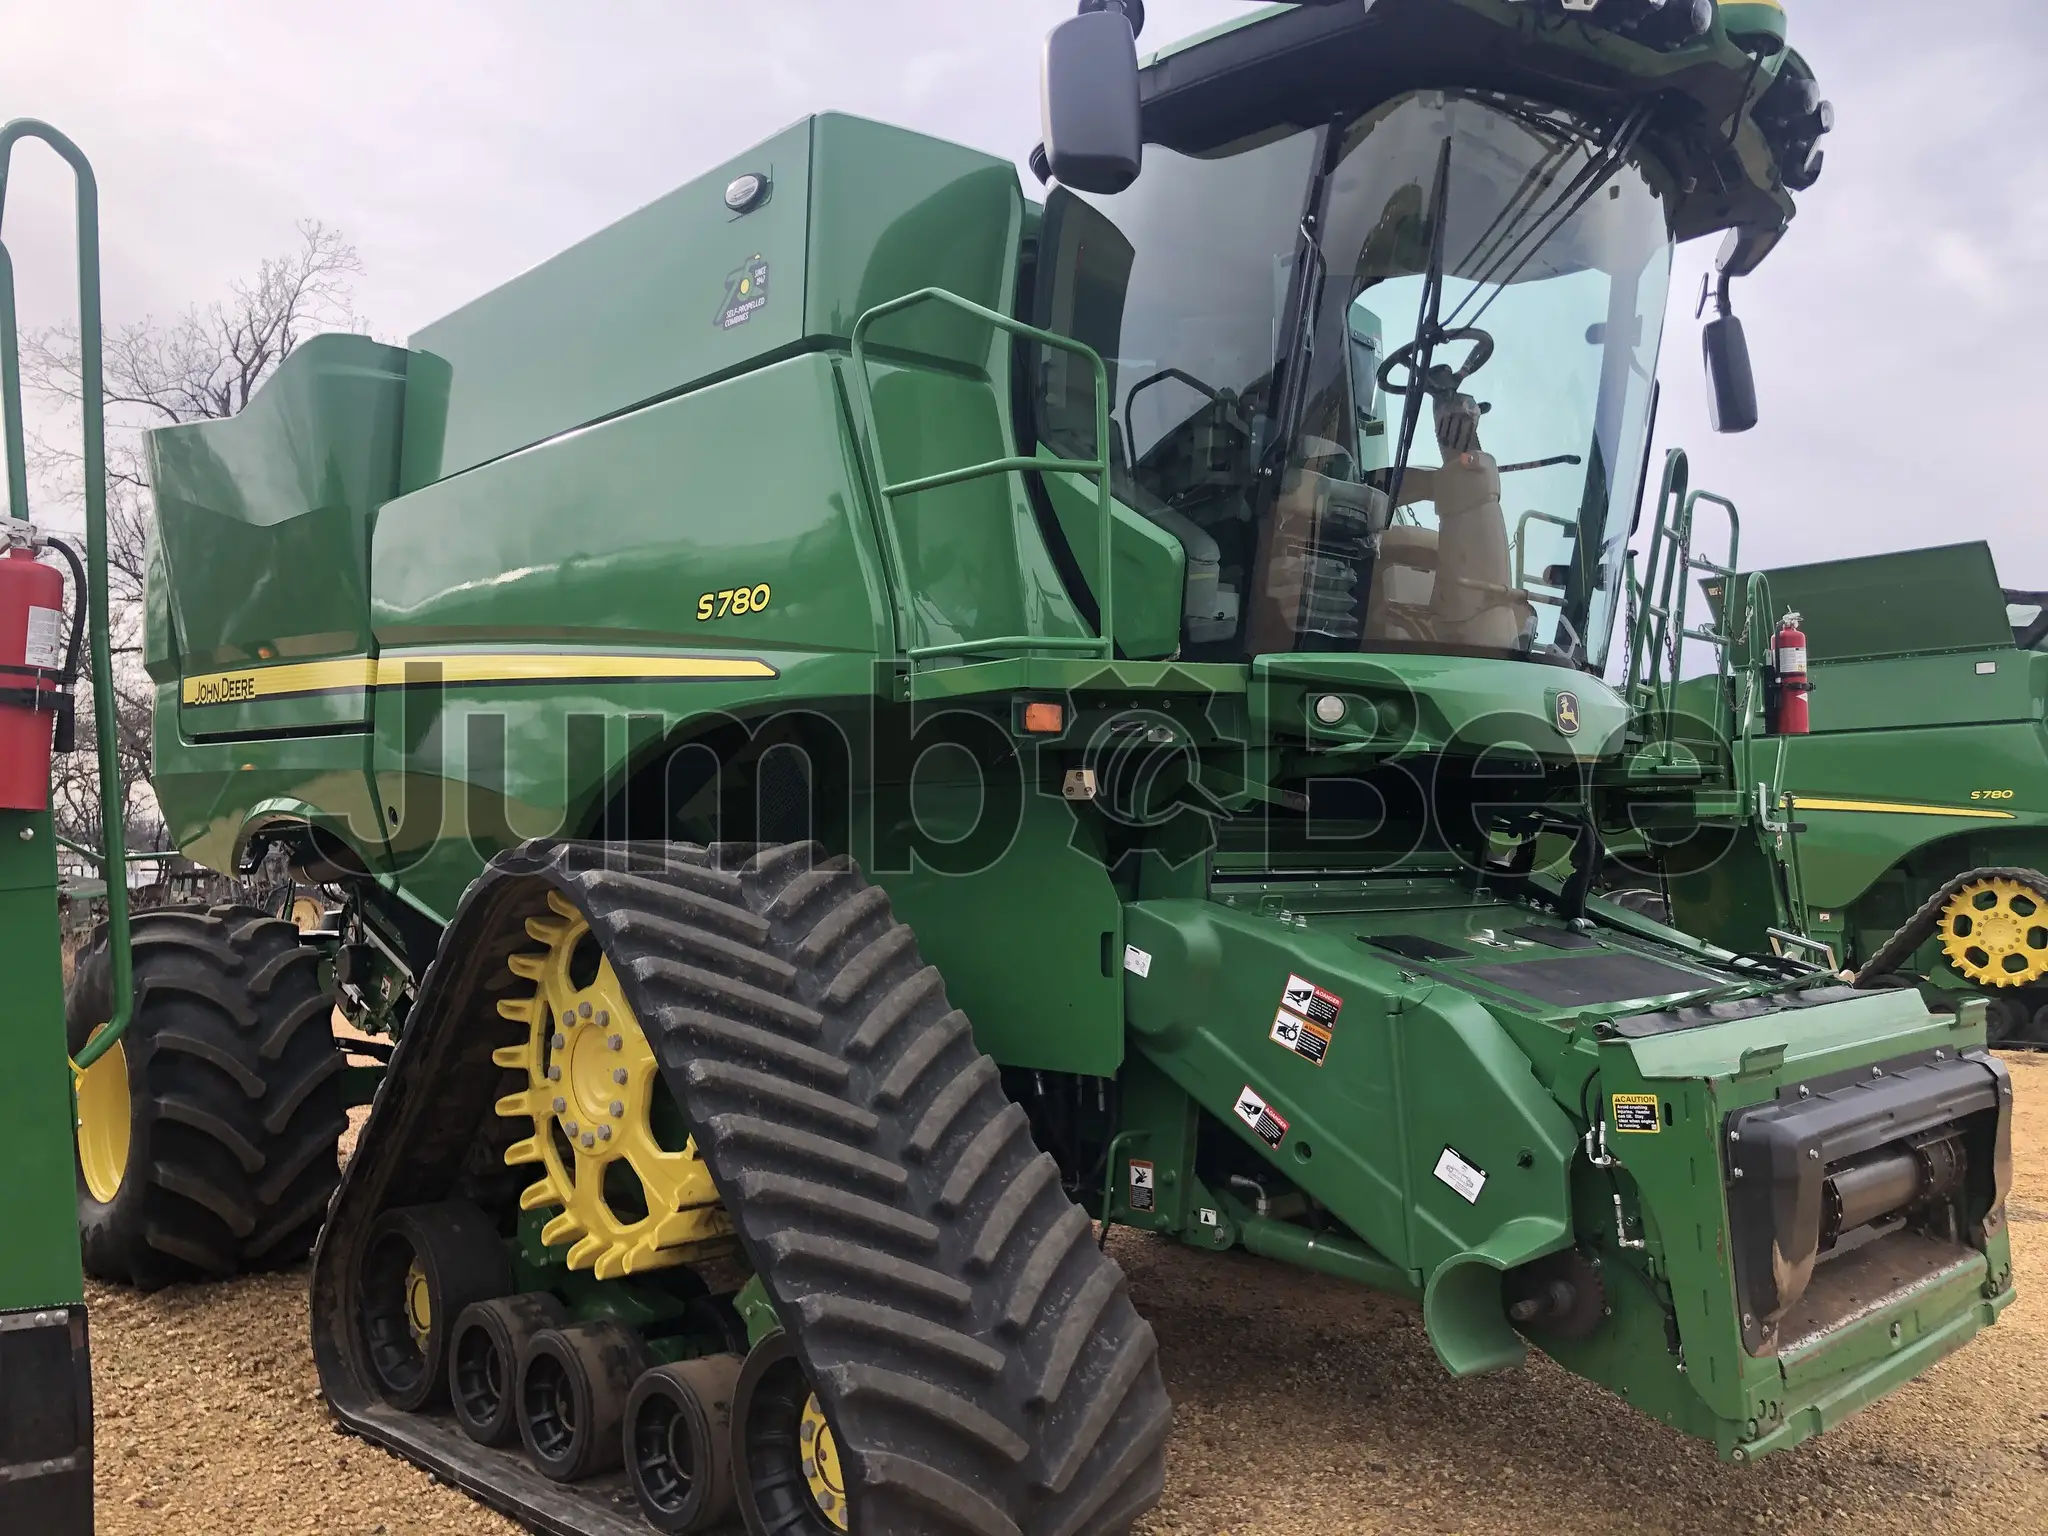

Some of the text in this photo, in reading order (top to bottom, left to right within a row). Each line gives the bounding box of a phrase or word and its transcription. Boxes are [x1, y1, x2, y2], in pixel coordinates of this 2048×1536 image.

[725, 297, 765, 319] SELF-PROPELLED
[724, 312, 749, 327] COMBINES
[697, 582, 771, 621] S780
[195, 678, 255, 703] JOHN DEERE
[1970, 789, 2014, 800] S780
[1319, 991, 1340, 1005] DANGER
[1268, 1110, 1287, 1129] DANGER
